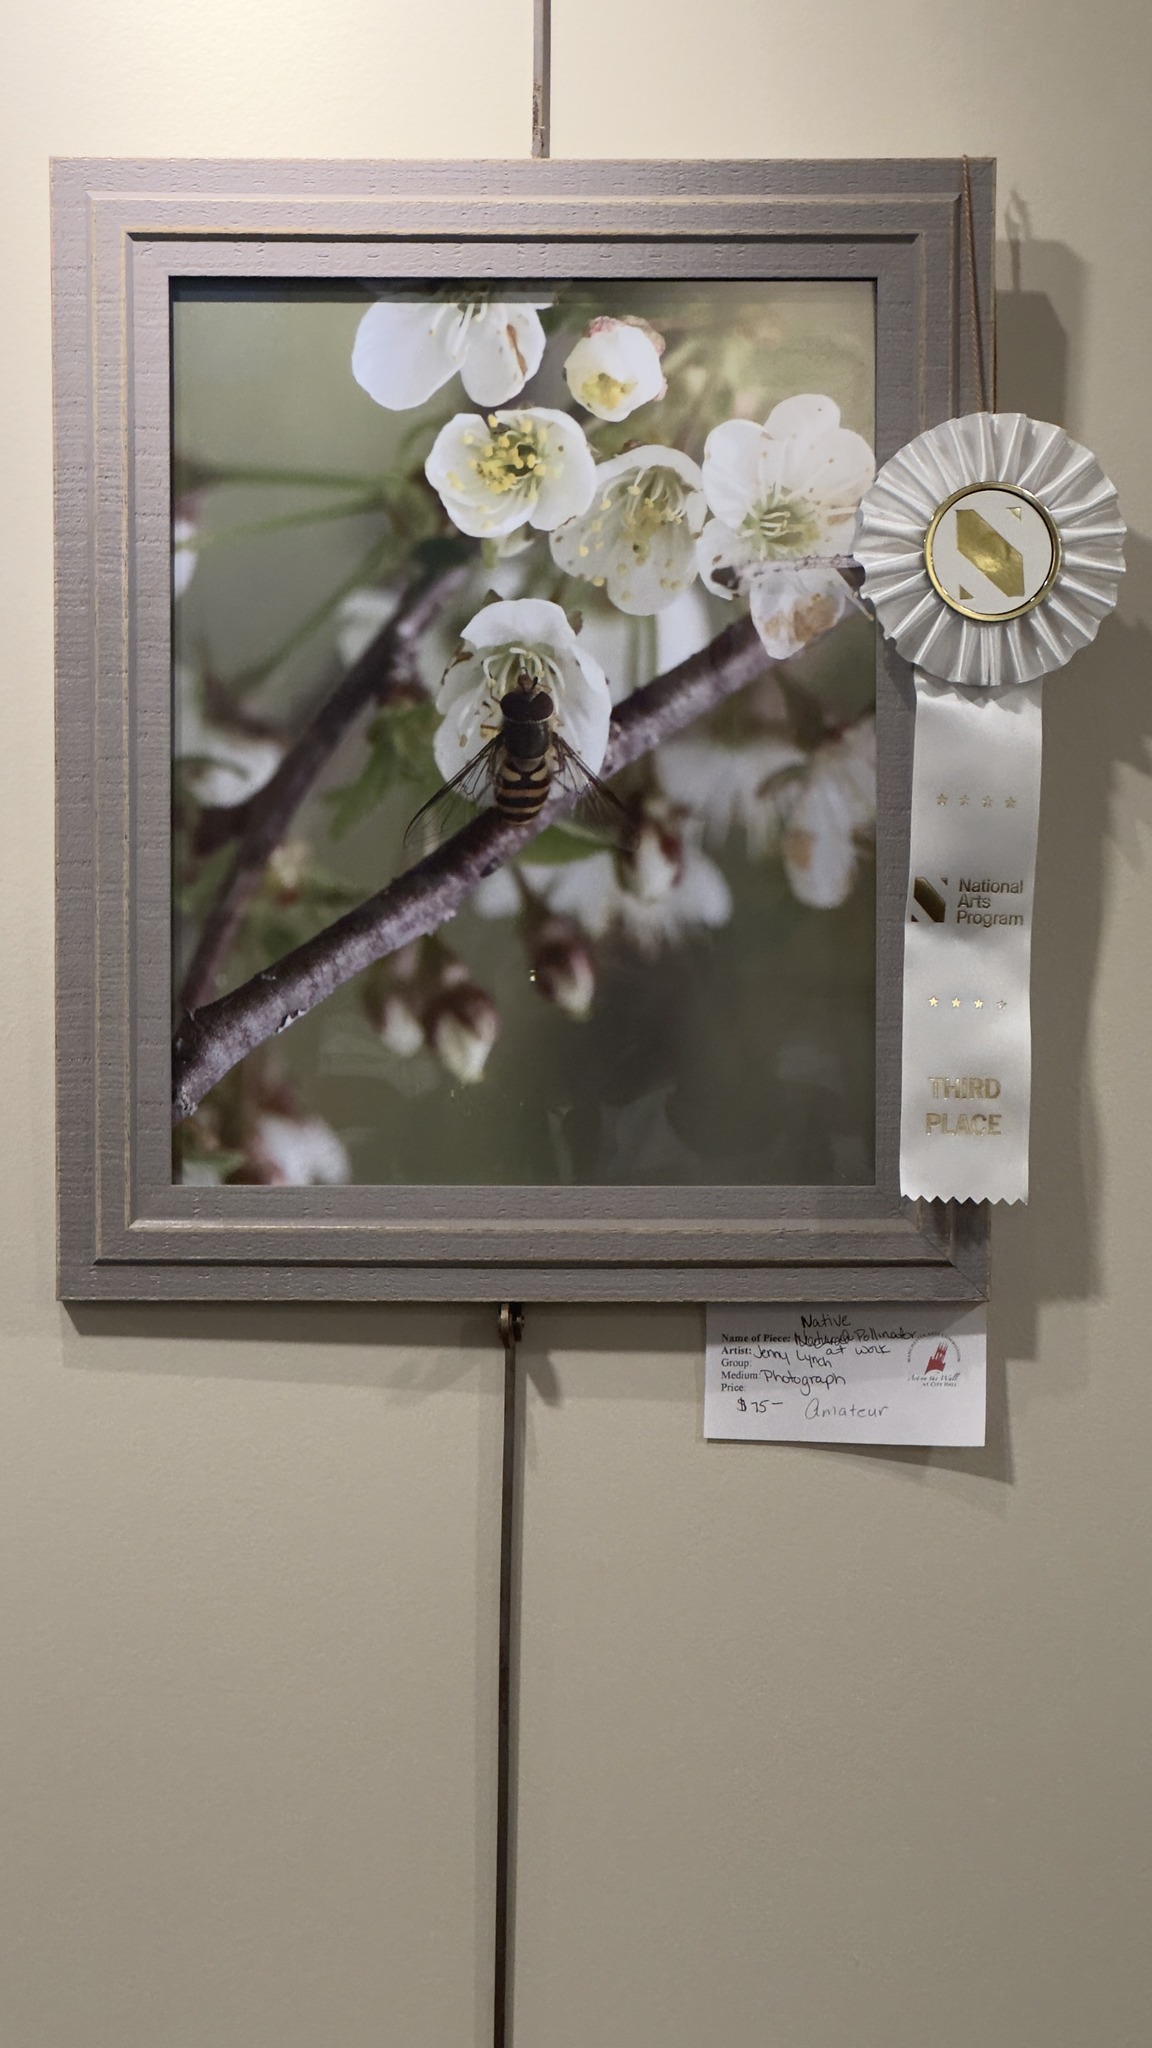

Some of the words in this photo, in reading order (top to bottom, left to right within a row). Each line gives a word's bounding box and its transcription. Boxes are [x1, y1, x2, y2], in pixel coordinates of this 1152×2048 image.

[959, 878, 1023, 894] National
[957, 894, 991, 909] Arts
[957, 910, 1024, 928] Program
[927, 1077, 1002, 1099] THIRD
[926, 1112, 1002, 1136] PLACE
[800, 1313, 851, 1329] Native
[721, 1333, 749, 1343] Name
[750, 1333, 761, 1343] of
[763, 1333, 791, 1343] Piece:
[855, 1327, 917, 1342] Pollinator
[721, 1346, 752, 1355] Artist:
[826, 1346, 847, 1355] at
[721, 1358, 752, 1369] Group:
[721, 1371, 760, 1380] Medium:
[760, 1369, 846, 1396] Photograph
